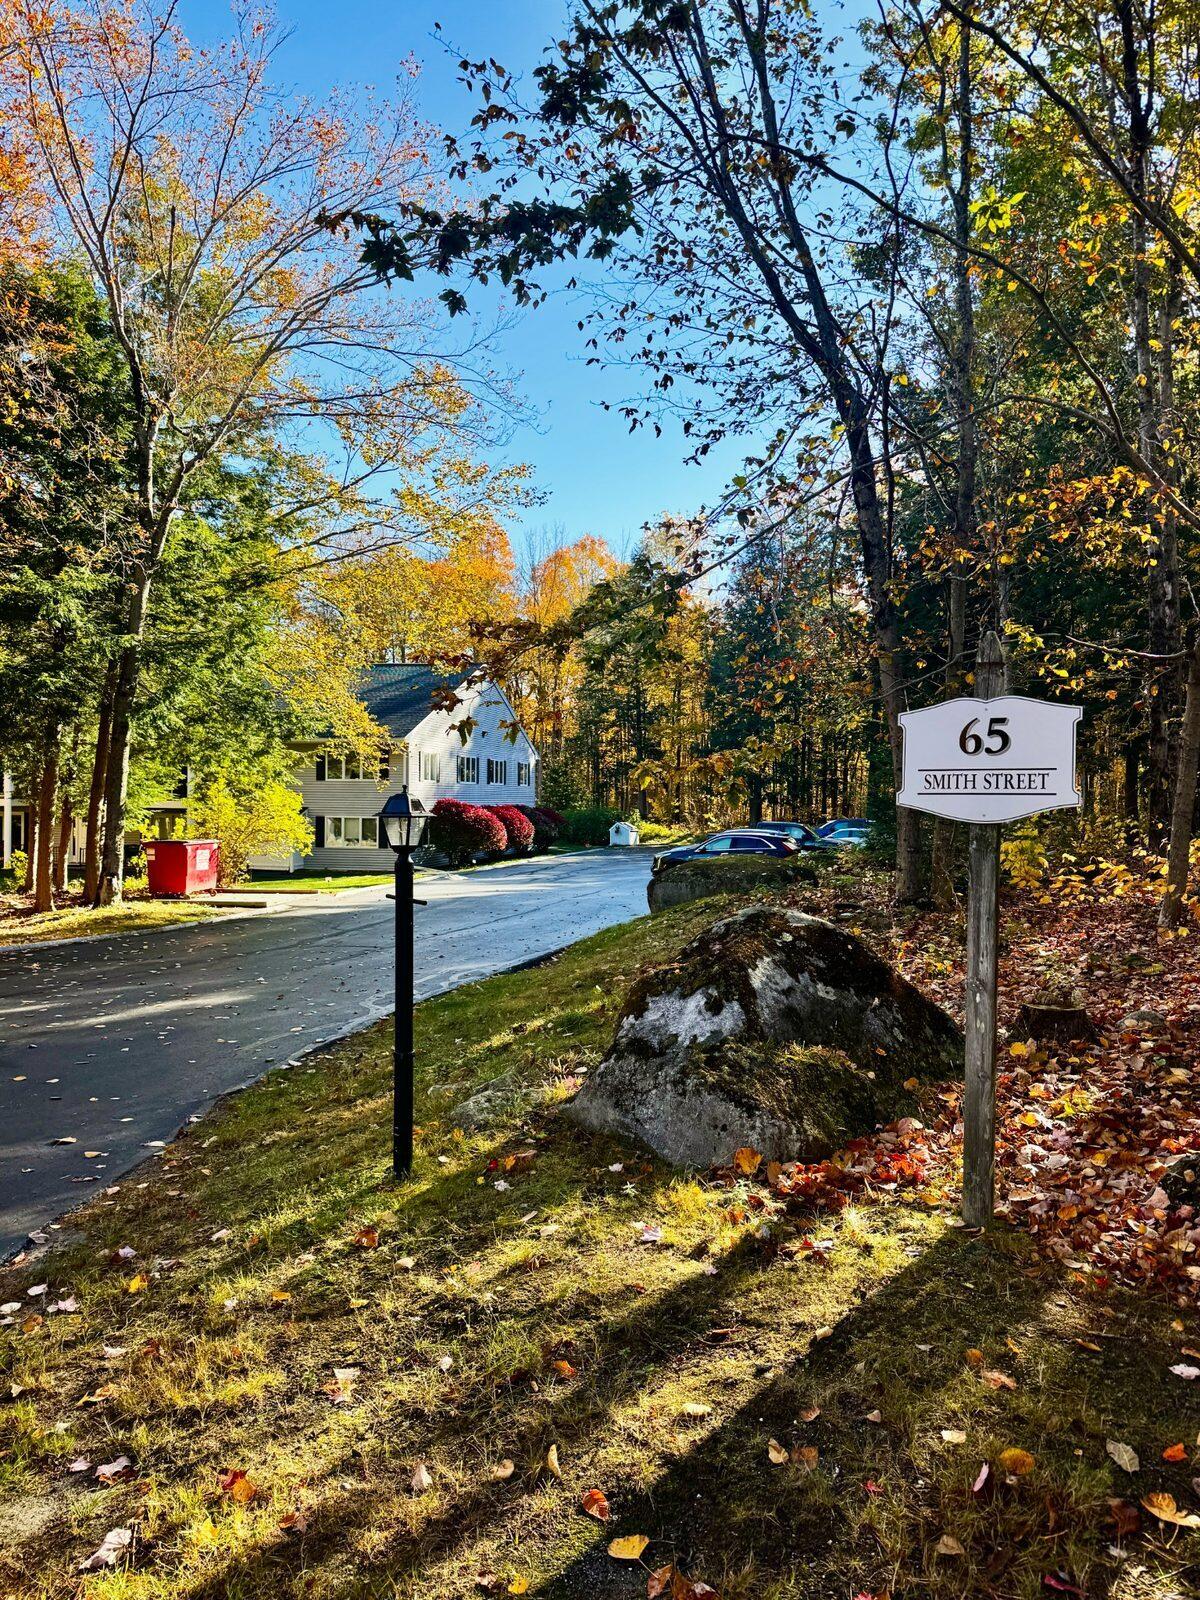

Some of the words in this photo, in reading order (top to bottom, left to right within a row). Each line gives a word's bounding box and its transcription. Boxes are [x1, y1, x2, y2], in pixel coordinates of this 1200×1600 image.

[958, 717, 1012, 757] 65
[923, 773, 977, 790] SMITH
[983, 772, 1050, 790] STREET
